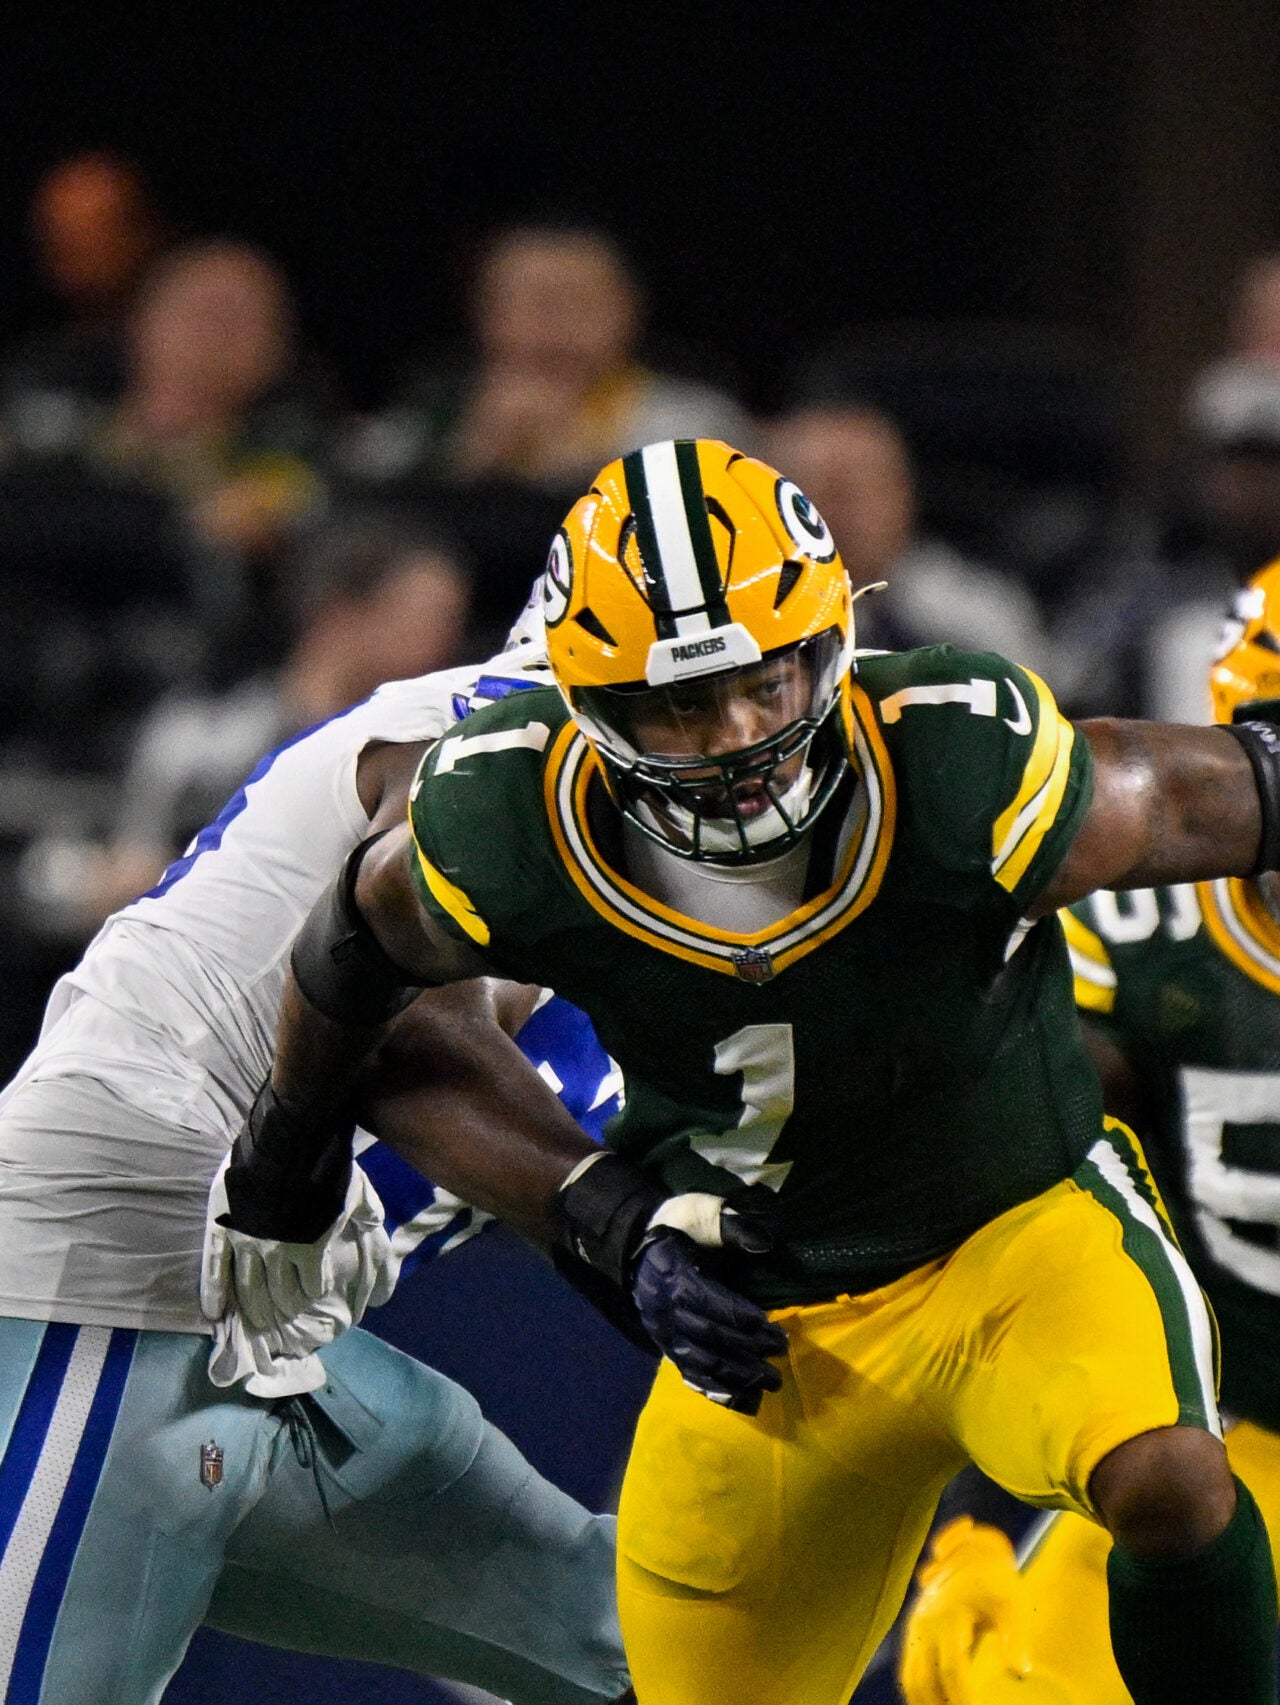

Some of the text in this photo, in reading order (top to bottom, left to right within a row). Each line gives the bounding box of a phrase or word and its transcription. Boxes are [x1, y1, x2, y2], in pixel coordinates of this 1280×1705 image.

[671, 636, 727, 662] PACKERS
[880, 678, 997, 724] 1
[434, 721, 551, 776] 1
[690, 1023, 795, 1193] 1
